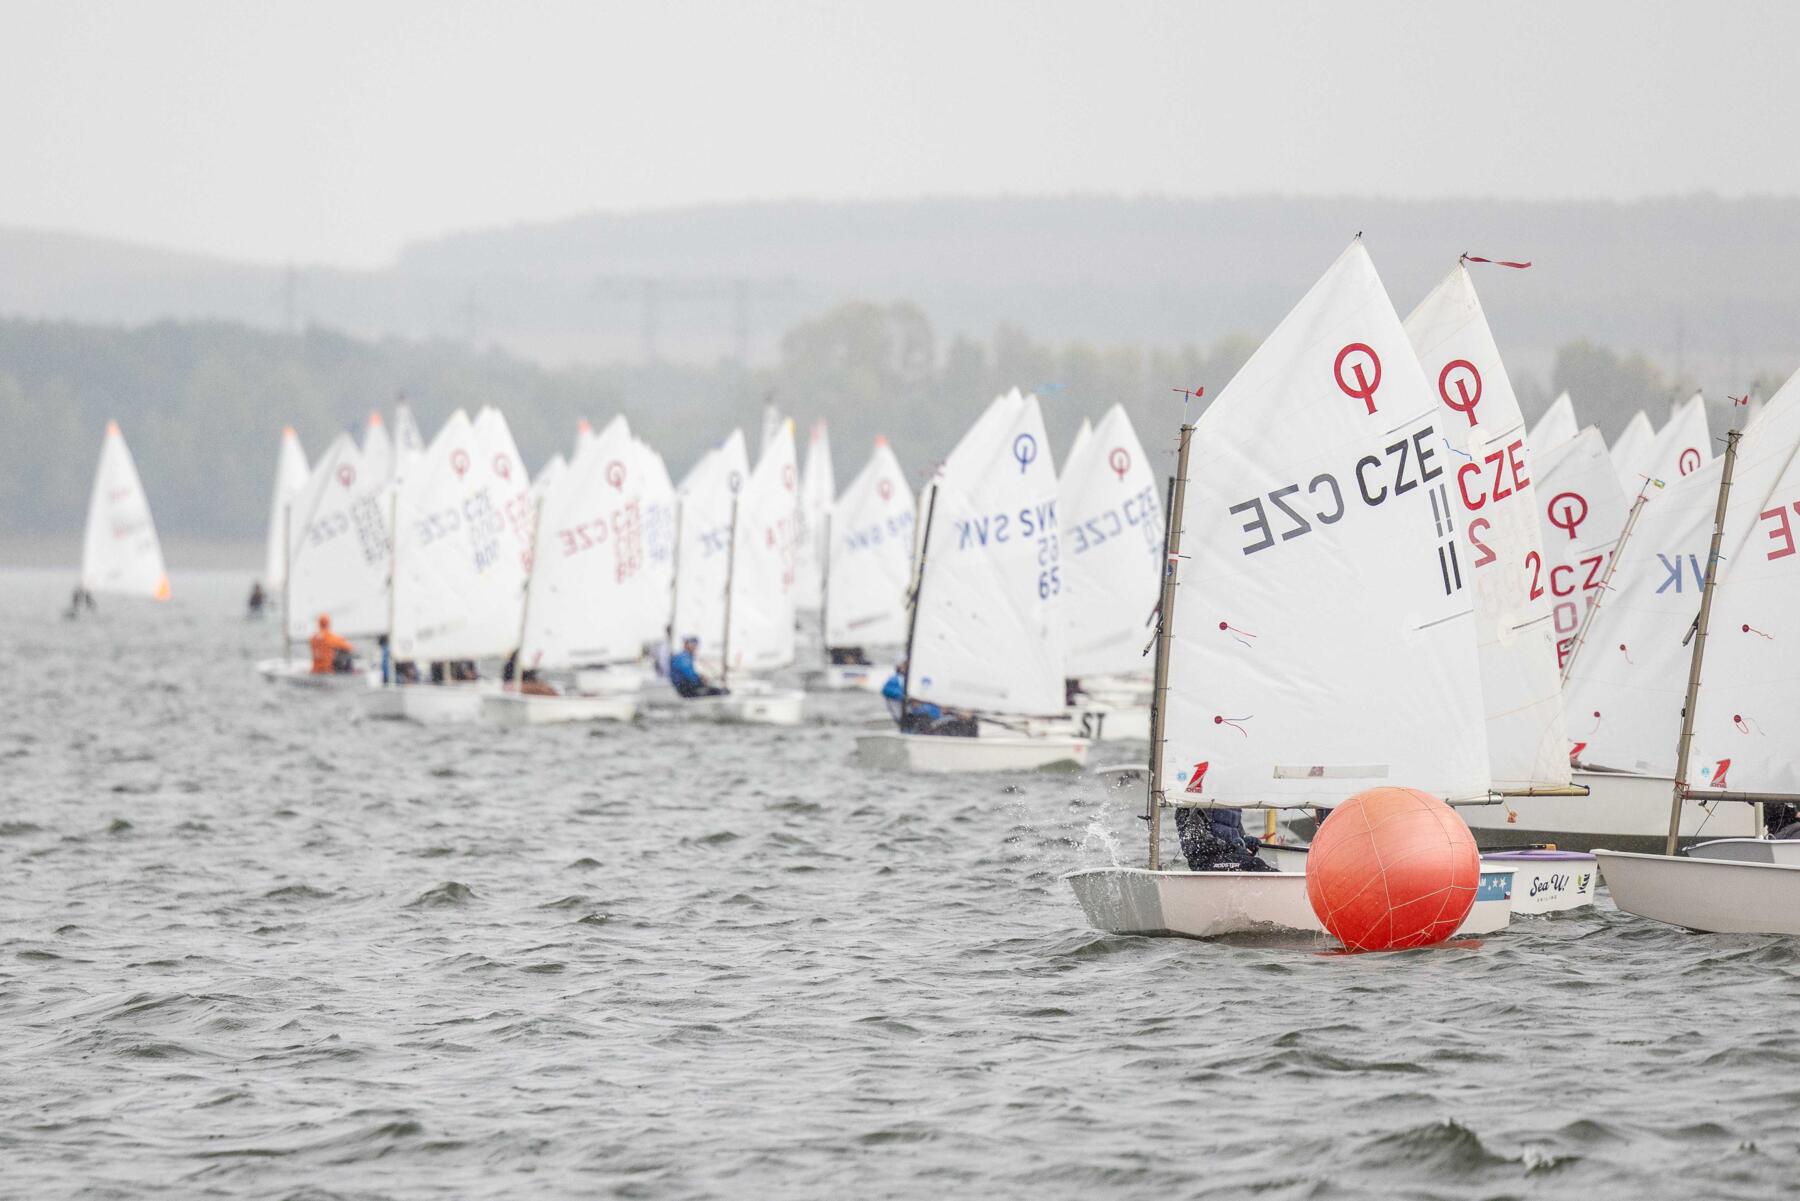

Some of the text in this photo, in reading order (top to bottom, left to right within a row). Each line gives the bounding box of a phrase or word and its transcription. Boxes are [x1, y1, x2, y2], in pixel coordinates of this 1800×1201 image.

[1355, 425, 1443, 506] CZE
[1457, 439, 1530, 511] CZE
[1525, 550, 1545, 601] 2
[1550, 550, 1614, 597] CZ
[1529, 876, 1549, 897] Sea
